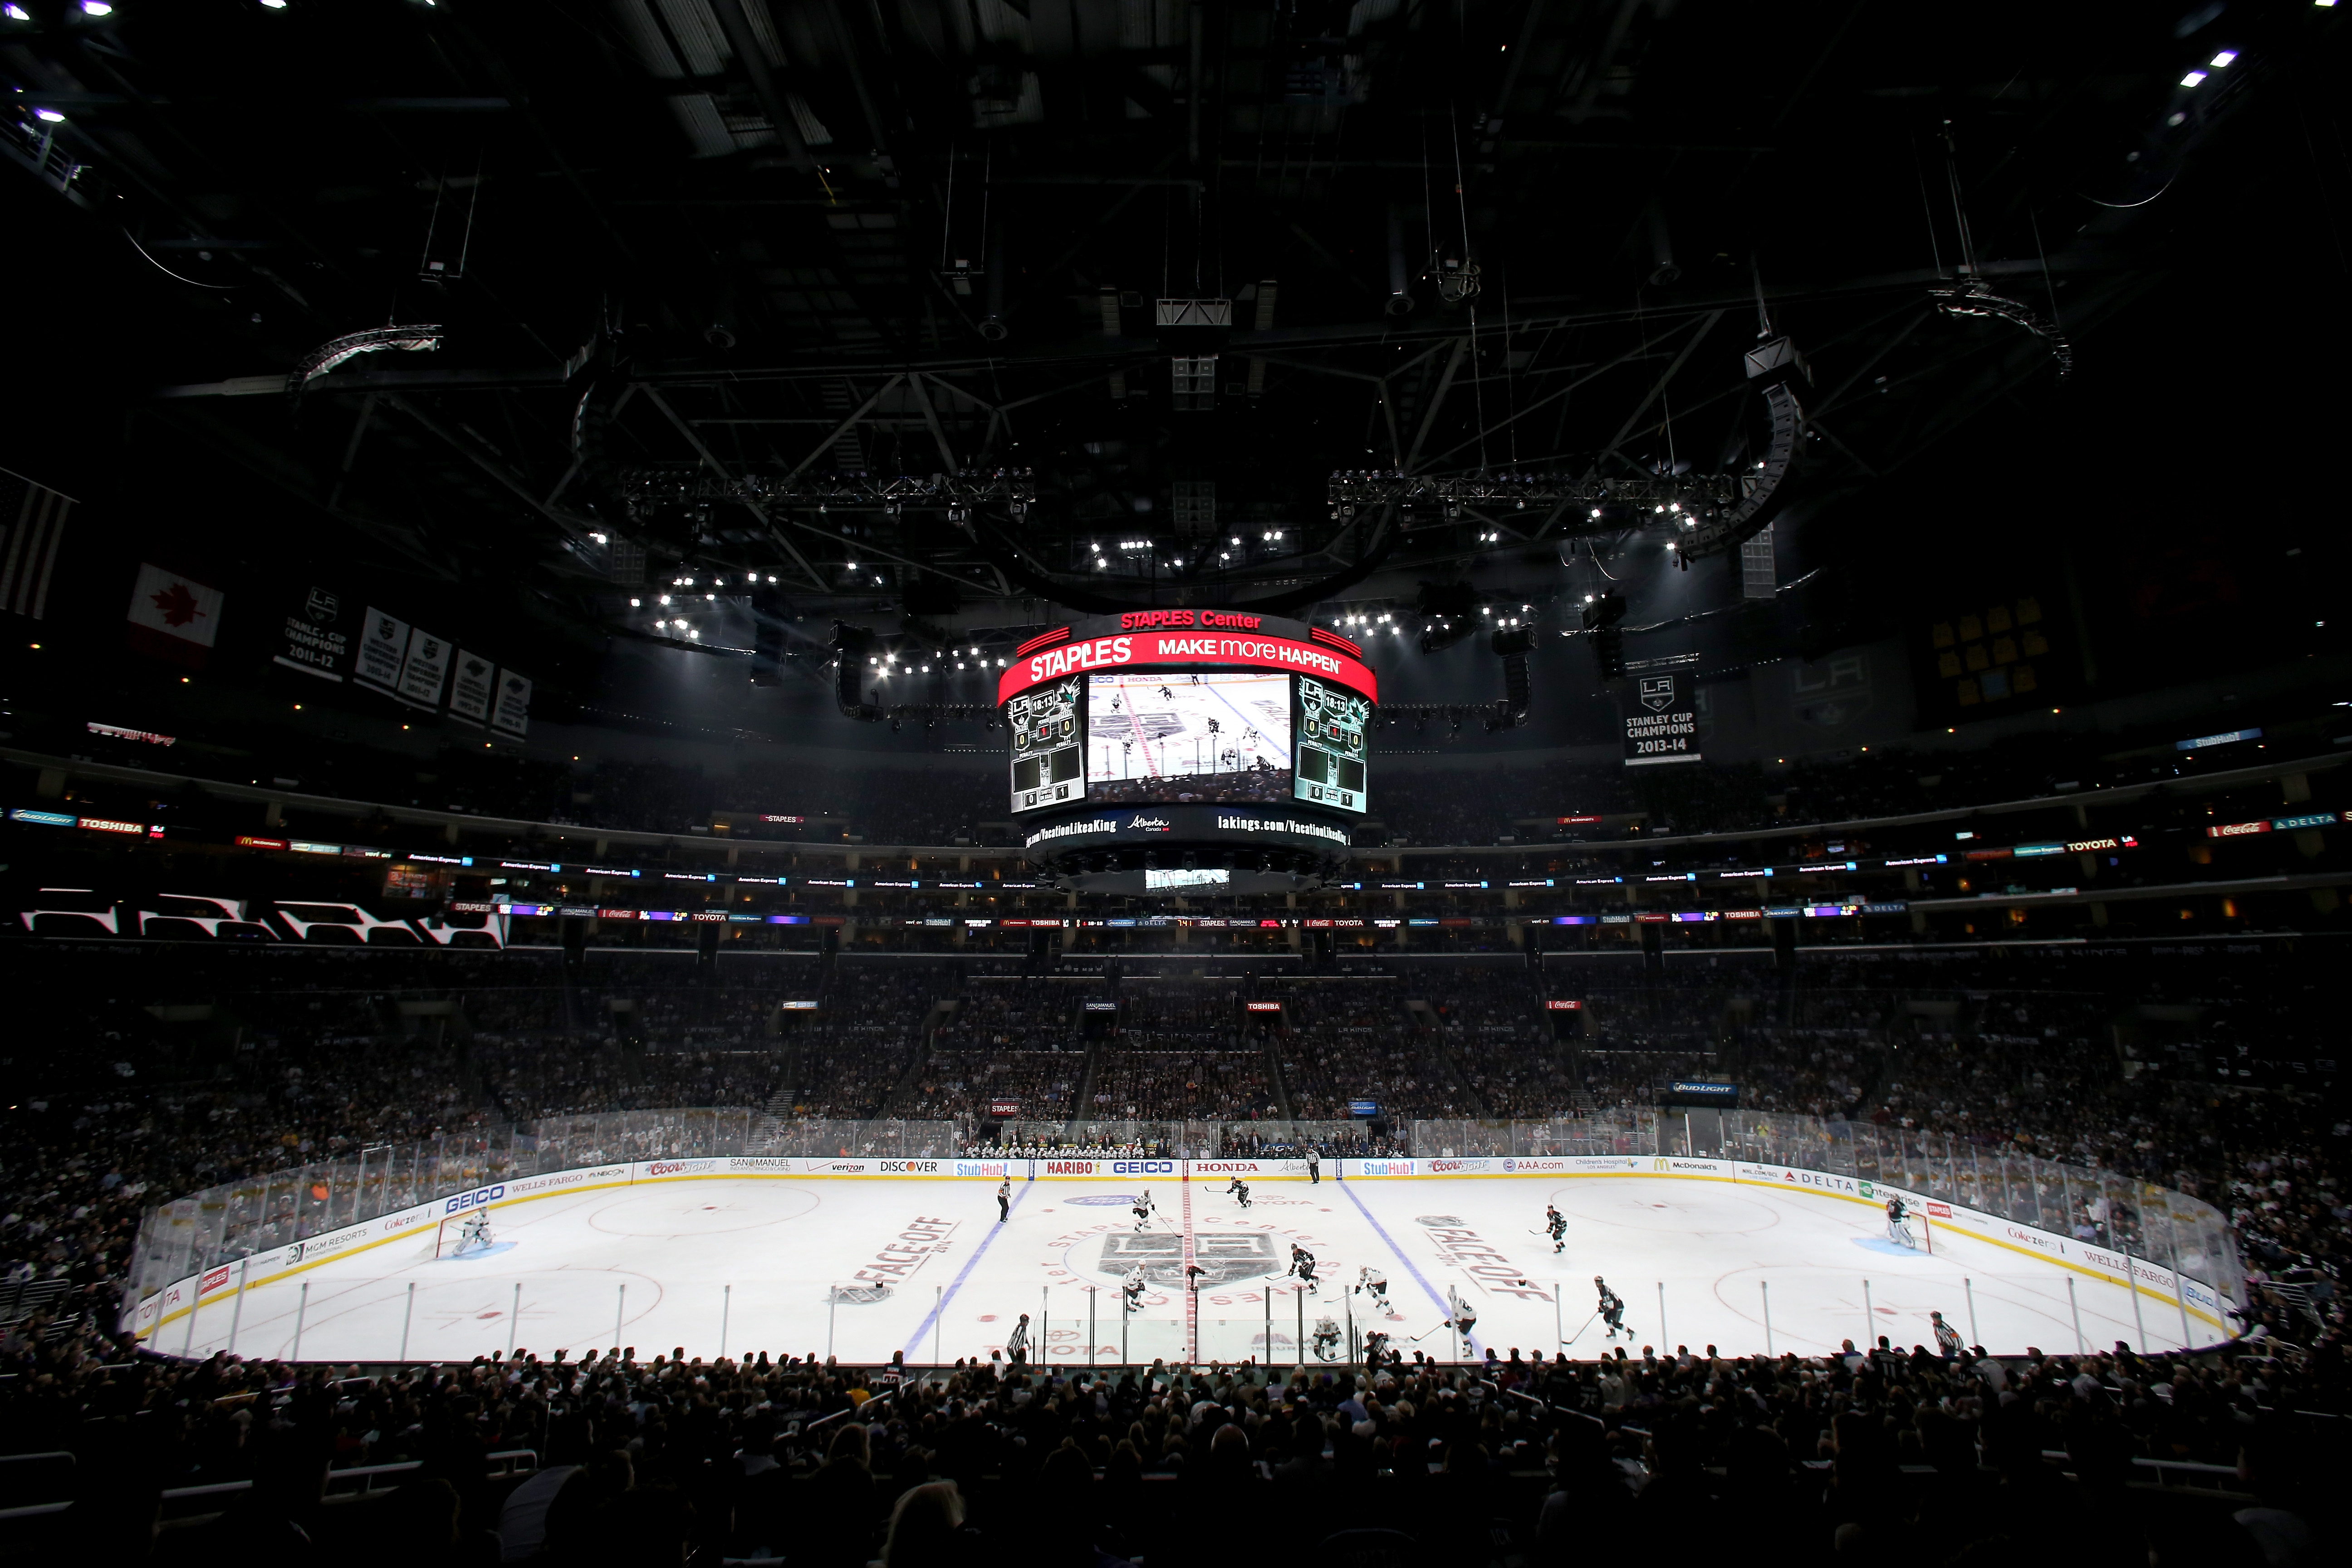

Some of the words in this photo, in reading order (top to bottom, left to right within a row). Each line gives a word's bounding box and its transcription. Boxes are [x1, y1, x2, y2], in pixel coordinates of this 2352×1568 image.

[312, 591, 338, 607] LA
[1121, 610, 1195, 628] STAPLES
[1200, 610, 1261, 628] Center
[287, 617, 323, 635] STANLE
[328, 632, 347, 644] CUP
[284, 627, 346, 655] CHAMPIONS
[370, 638, 398, 653] WESTERN
[289, 644, 335, 668] 2011-12
[363, 644, 400, 664] CONFERENCE
[1031, 637, 1132, 681] STAPLES
[1158, 639, 1216, 655] MAKE
[1221, 640, 1276, 659] more
[1279, 646, 1340, 674] HAPPEN
[364, 654, 397, 671] CHAMPIONS
[412, 657, 439, 671] WESTERN
[1305, 682, 1322, 698] LA
[1643, 680, 1670, 692] LA
[1014, 699, 1029, 713] LA
[1033, 698, 1053, 711] 18:13
[1326, 696, 1345, 711] 18:13
[1305, 709, 1319, 718] KINGS
[1627, 714, 1670, 727] STANLEY
[1672, 712, 1693, 722] CUP
[1015, 724, 1028, 732] KINGS
[1041, 727, 1046, 735] 1
[1064, 720, 1069, 731] 0
[1309, 721, 1314, 731] 0
[1627, 723, 1695, 738] CHAMPIONS
[1020, 735, 1024, 745] 0
[1056, 740, 1071, 748] PENALTY
[1308, 740, 1323, 748] PENALTY
[1353, 735, 1357, 745] 0
[1637, 738, 1687, 753] 2013-14
[2195, 731, 2240, 747] StubHub!
[1019, 751, 1033, 759] PENALTY
[1345, 750, 1358, 759] PENALTY
[1060, 788, 1065, 796] 1
[1314, 788, 1319, 797] 0
[1029, 795, 1033, 804] 0
[1345, 795, 1349, 804] 1
[81, 819, 142, 833] TOSHIBA
[1127, 815, 1170, 828] Alberta
[2288, 815, 2336, 827] DELTA
[1218, 816, 1346, 846] lakings.com/VacationLikeaKing
[2067, 838, 2117, 852] TOYOTA
[455, 903, 491, 911] STAPLES
[650, 1162, 685, 1175] Coors
[681, 1161, 715, 1174] LIGHT
[832, 1163, 864, 1172] verizon
[880, 1161, 938, 1172] DISCOVER
[957, 1161, 1008, 1176] StubHub!
[1047, 1161, 1092, 1174] HARIBO
[1113, 1161, 1173, 1173] GEICO
[1196, 1163, 1260, 1171] HONDA
[1364, 1161, 1415, 1175] StubHub!
[1432, 1160, 1461, 1172] Coors
[1518, 1161, 1564, 1169] AAA.com
[1673, 1161, 1717, 1171] McDonald's
[512, 1181, 546, 1194] WELLS
[549, 1174, 583, 1186] FARGO
[1802, 1173, 1854, 1191] DELTA
[445, 1185, 505, 1215] GEICO
[1928, 1205, 1951, 1215] STAPLES
[305, 1240, 327, 1254] MGM
[328, 1228, 368, 1246] RESORTS
[930, 1240, 954, 1254] 2014
[1113, 1237, 1264, 1254] LA
[304, 1245, 342, 1259] INTERNATIONAL
[854, 1216, 953, 1284] FACE-OFF
[1429, 1228, 1555, 1303] FACE-OFF
[2084, 1250, 2128, 1271] WELLS
[2132, 1266, 2174, 1289] FARGO
[137, 1289, 180, 1322] TOYTA
